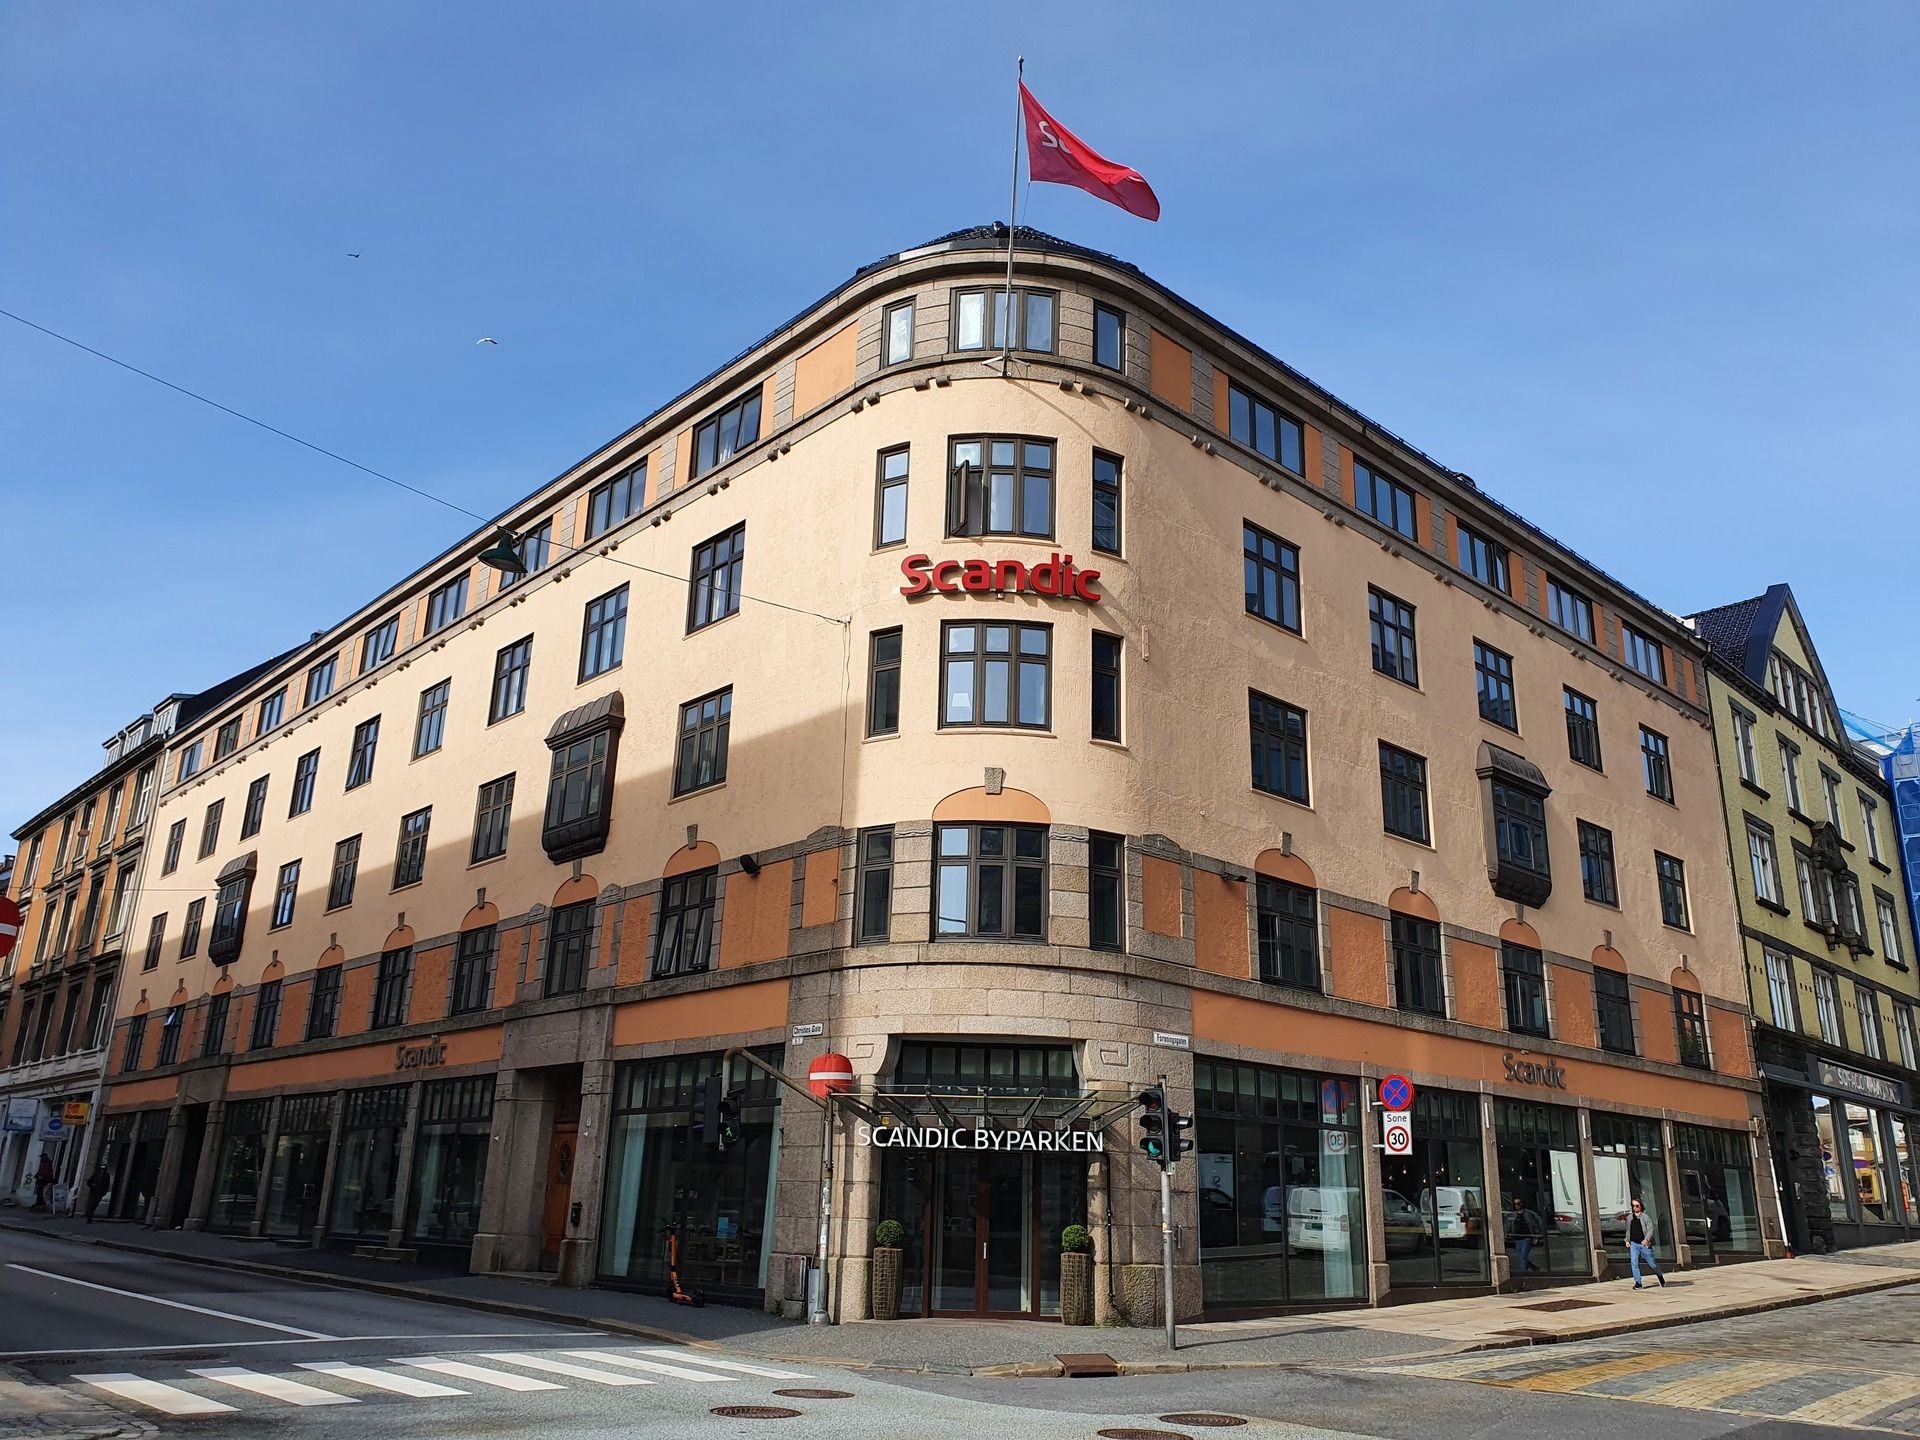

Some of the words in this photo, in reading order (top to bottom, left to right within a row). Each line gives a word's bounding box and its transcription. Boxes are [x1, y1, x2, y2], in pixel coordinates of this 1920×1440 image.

[900, 553, 1101, 602] Scandic
[395, 1037, 447, 1070] Scandic
[1503, 1053, 1566, 1089] Scandic
[1387, 1114, 1407, 1123] Sone
[858, 1126, 967, 1149] SCANDIC
[974, 1129, 1104, 1152] BYPARKEN
[1391, 1133, 1405, 1145] 30
